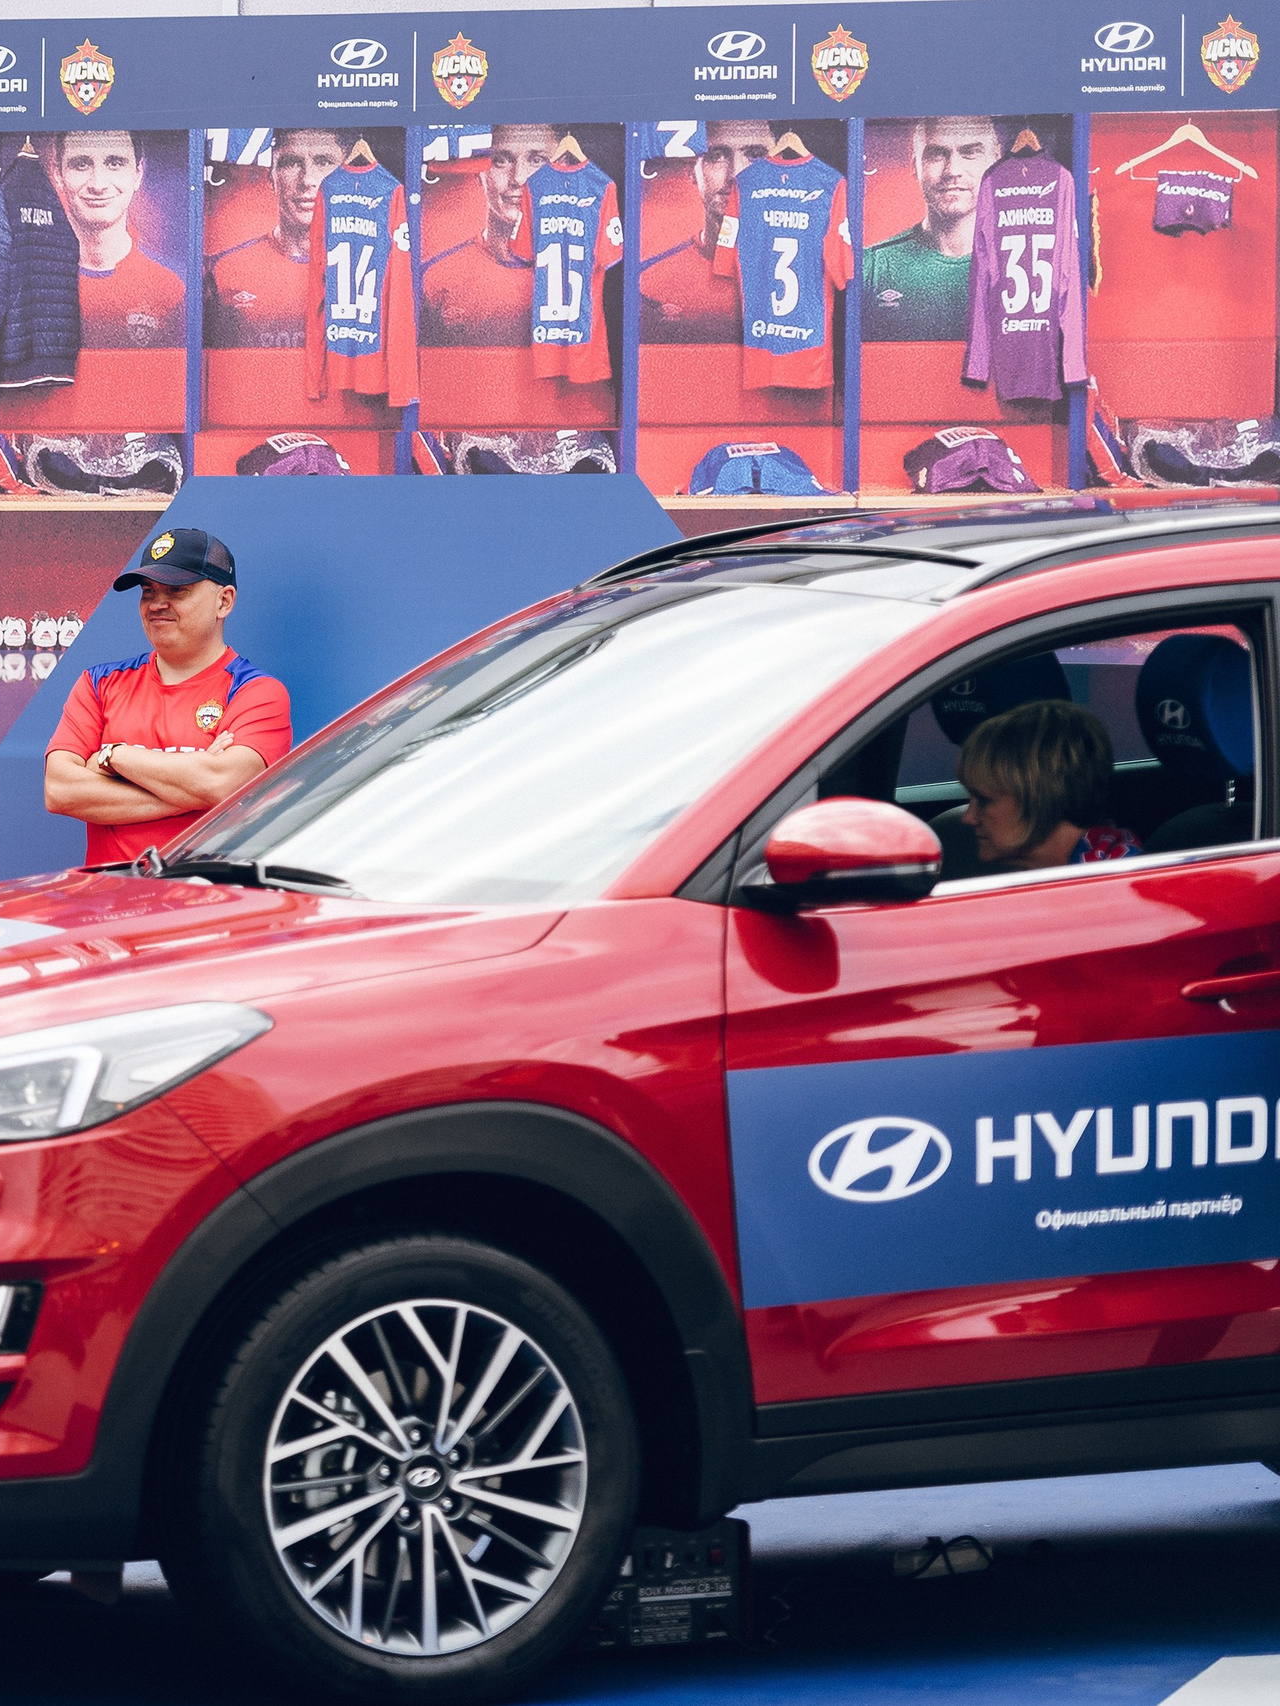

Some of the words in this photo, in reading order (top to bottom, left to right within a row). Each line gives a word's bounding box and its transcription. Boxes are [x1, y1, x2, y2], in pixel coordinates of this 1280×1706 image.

[815, 47, 865, 71] ЦСКА
[1204, 38, 1255, 62] ЦСКА
[64, 61, 111, 84] ЦСКА
[436, 55, 484, 78] ЦСКА
[694, 65, 778, 81] HYUNDAI
[1080, 56, 1166, 72] HYUNDAI
[317, 73, 399, 88] HYUNDAI
[763, 210, 810, 230] ЧЕРНОВ
[998, 206, 1054, 228] АКИНФЕЕВ
[327, 241, 377, 325] 14
[536, 242, 584, 323] 15
[770, 237, 799, 317] 3
[1000, 233, 1056, 315] 35
[975, 1095, 1280, 1185] HYUND
[1035, 1199, 1167, 1232] Официальный
[1168, 1193, 1244, 1218] партнёр
